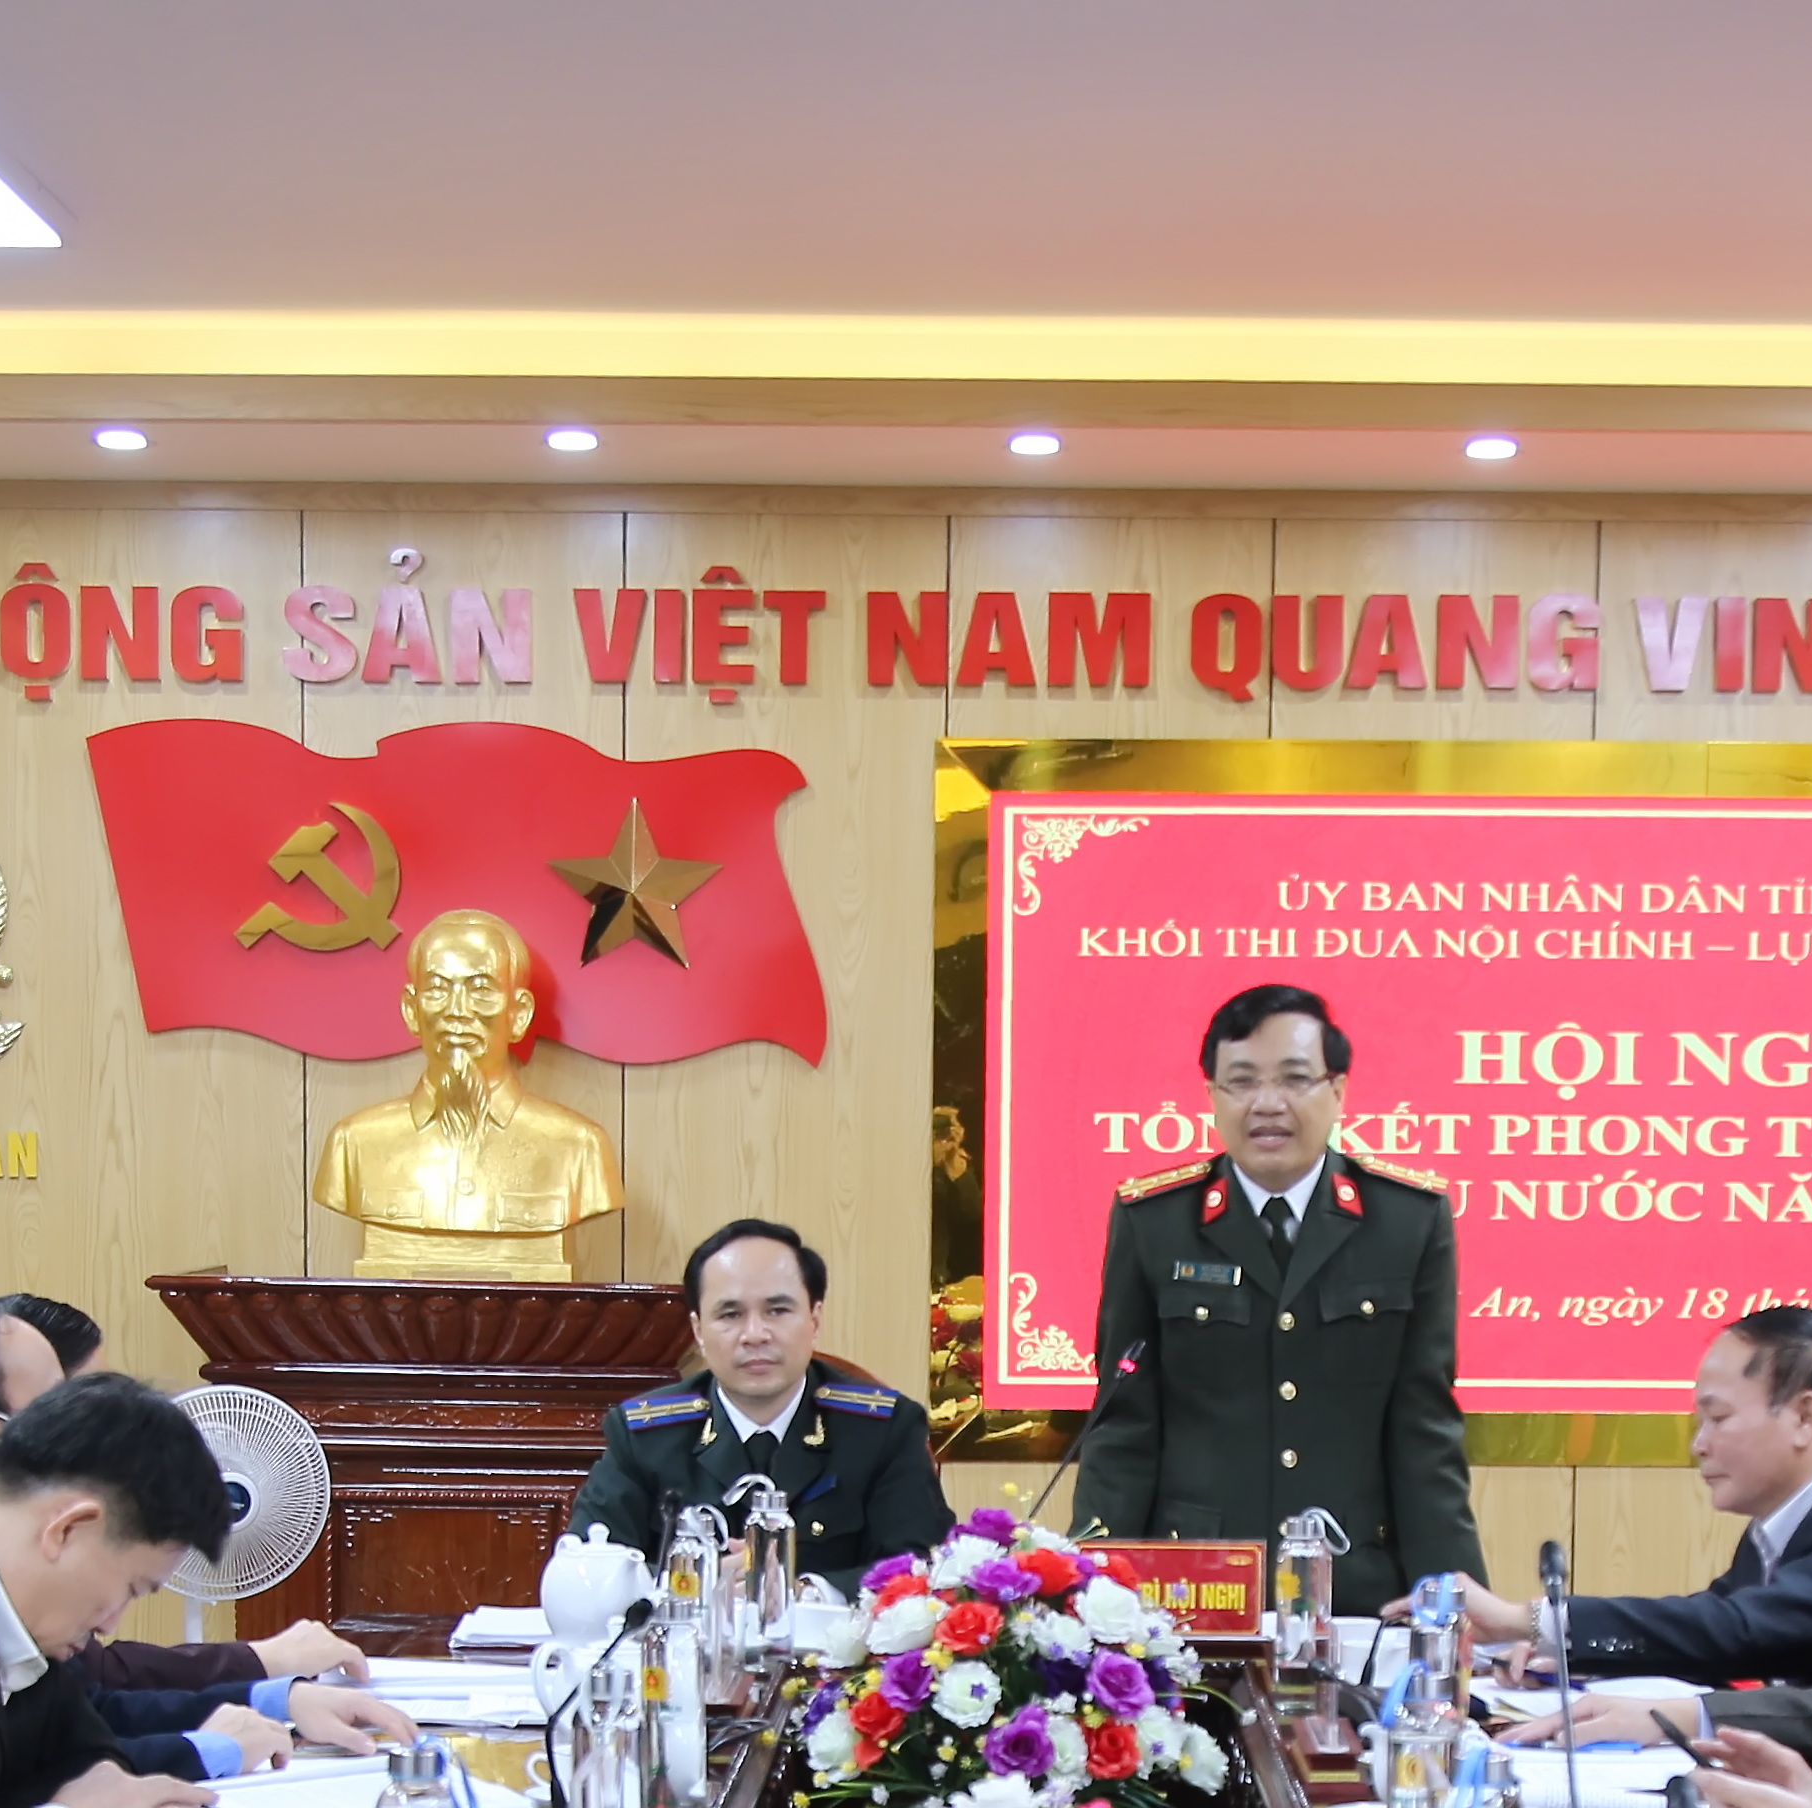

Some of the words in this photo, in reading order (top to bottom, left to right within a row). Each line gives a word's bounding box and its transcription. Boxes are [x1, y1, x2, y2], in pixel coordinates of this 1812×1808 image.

[282, 548, 533, 687] SẢN
[573, 567, 827, 705] VIỆT
[866, 591, 1152, 690] NAM
[1189, 592, 1599, 700] QUANG
[1278, 873, 1348, 912] ỦY
[1362, 881, 1465, 913] BAN
[1480, 874, 1624, 915] NHÂN
[1640, 874, 1746, 915] DÂN
[1078, 918, 1202, 958] KHỐI
[1216, 927, 1299, 958] THI
[1313, 928, 1422, 959] ĐUA
[1433, 924, 1521, 964] NỘI
[1534, 920, 1694, 961] CHÍNH
[1454, 1022, 1643, 1101] HỘI
[1336, 1102, 1471, 1156] KẾT
[1488, 1114, 1750, 1158] PHONG
[1490, 1168, 1704, 1222] NƯỚC
[1469, 1286, 1541, 1322] An,
[1558, 1286, 1664, 1327] ngày
[1676, 1287, 1730, 1319] 18
[1201, 1583, 1247, 1616] NGHỊ
